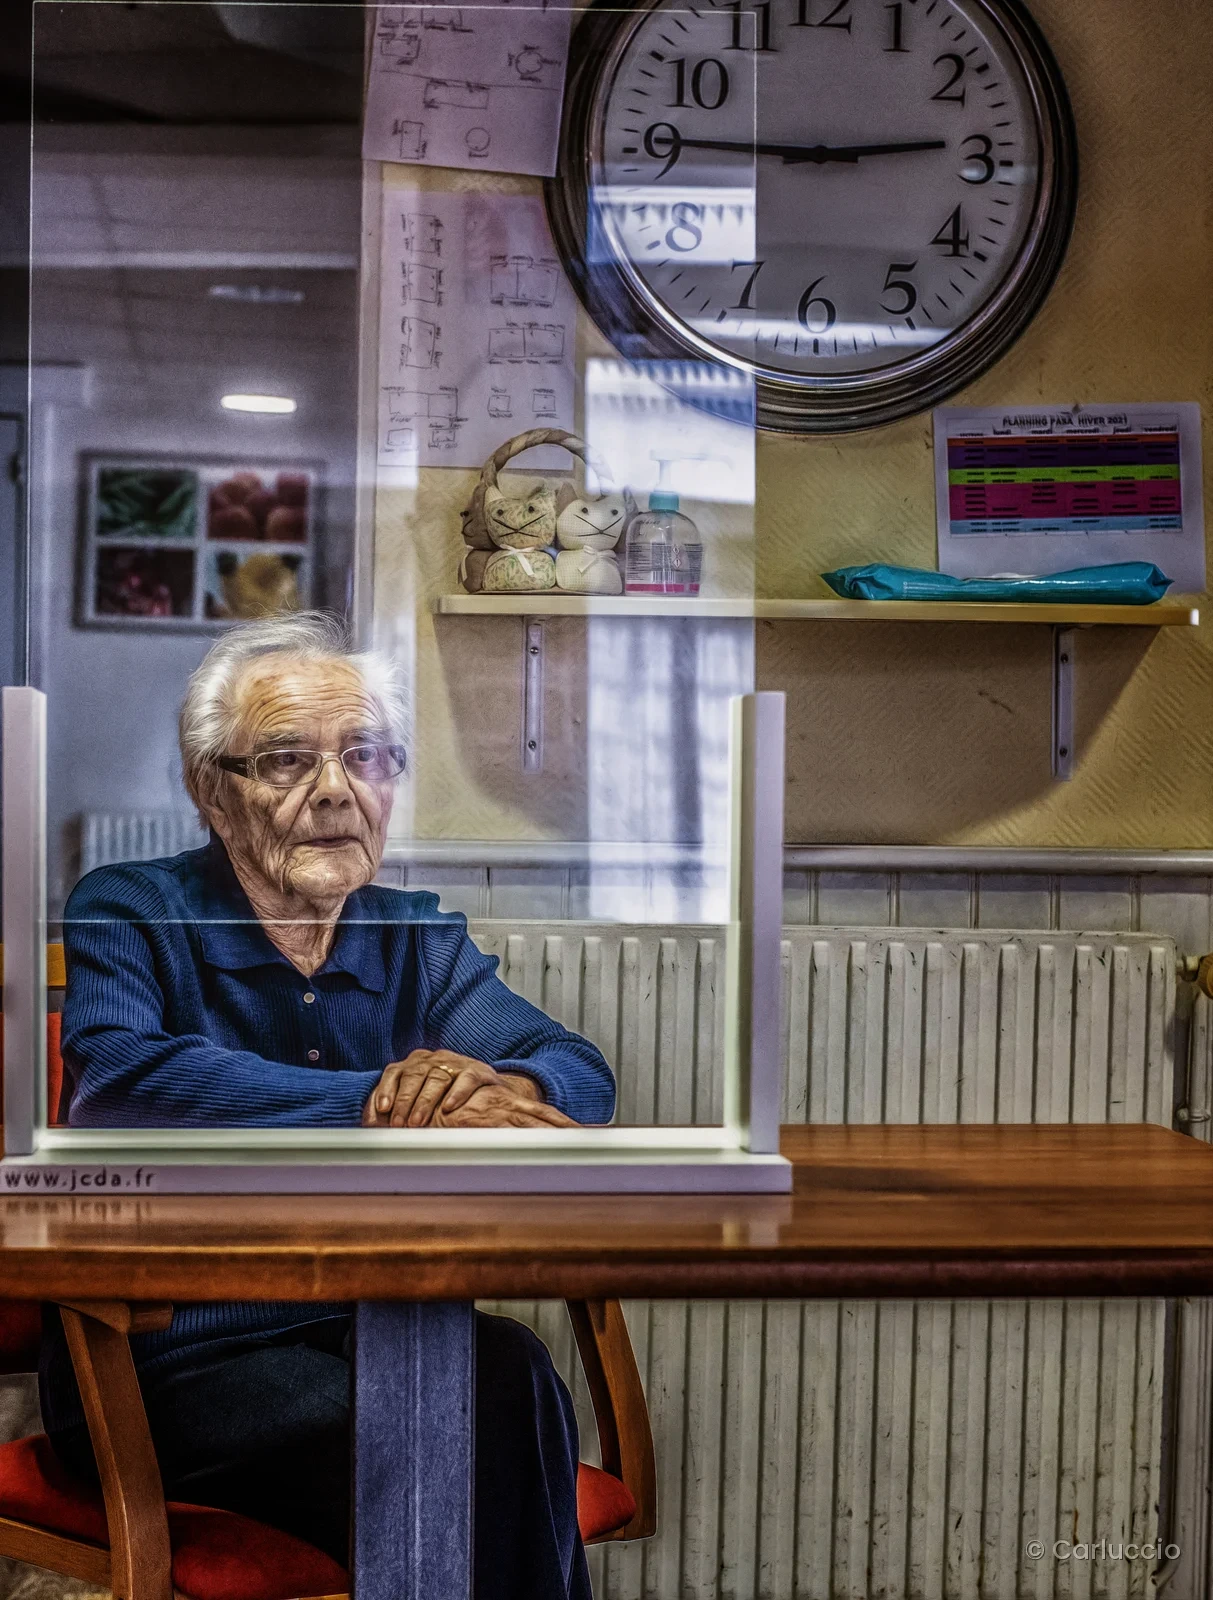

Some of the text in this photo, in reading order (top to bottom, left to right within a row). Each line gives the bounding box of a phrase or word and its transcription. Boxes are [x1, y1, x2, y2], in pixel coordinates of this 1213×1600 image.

[722, 1, 779, 52] 11
[788, 0, 853, 35] 12
[882, 2, 910, 53] 1
[665, 57, 730, 111] 10
[932, 53, 968, 108] 2
[643, 122, 682, 180] 9
[957, 133, 995, 185] 3
[664, 201, 704, 253] 8
[929, 203, 970, 258] 4
[730, 259, 766, 310] 7
[797, 275, 837, 334] 6
[879, 259, 919, 315] 5
[1003, 416, 1048, 427] PLANNING
[1077, 414, 1106, 426] HIVER
[1107, 413, 1128, 425] 2021
[1144, 425, 1177, 433] vendredi
[4, 1167, 156, 1191] www.jcda.fr
